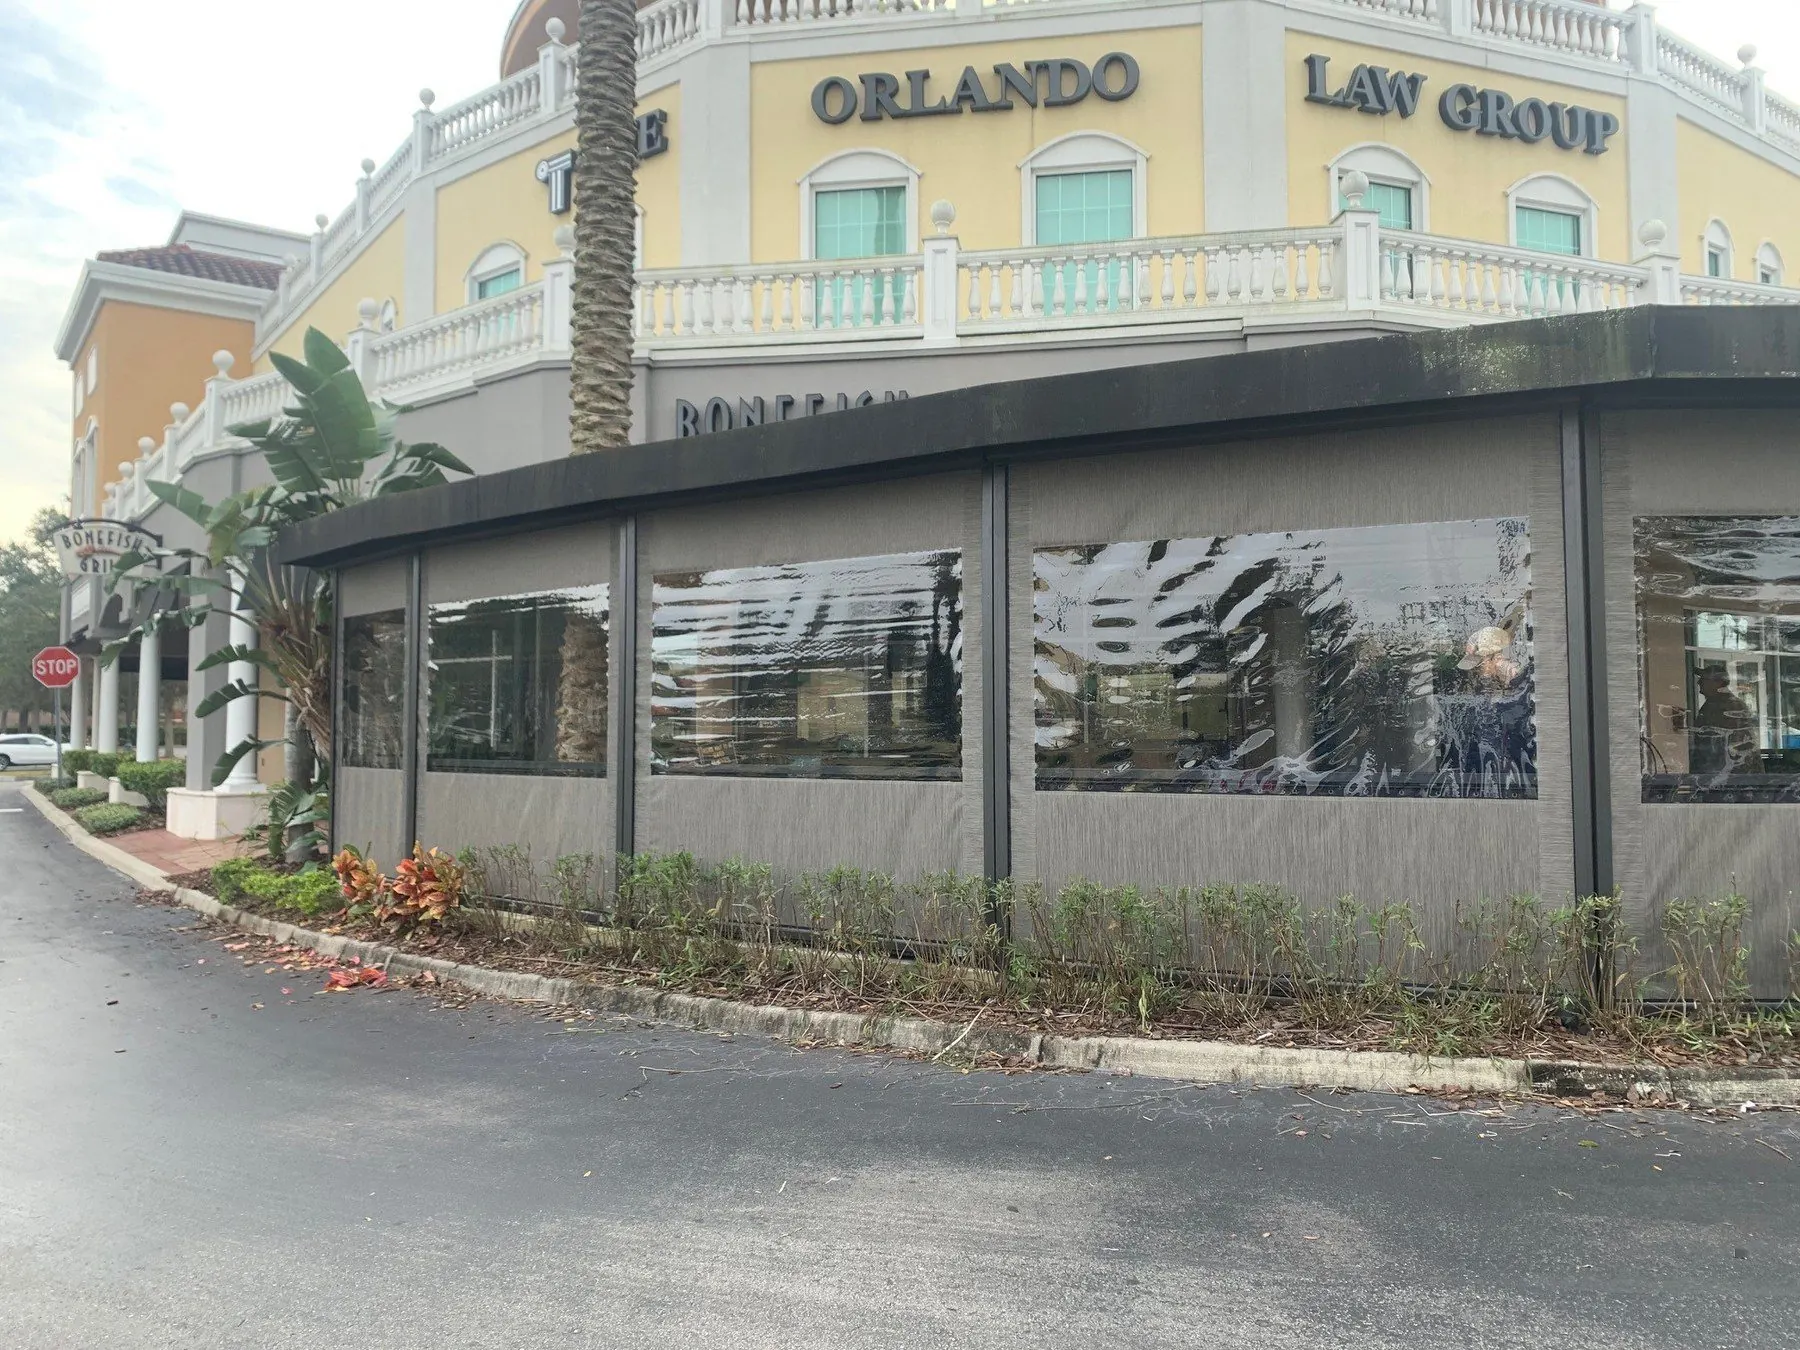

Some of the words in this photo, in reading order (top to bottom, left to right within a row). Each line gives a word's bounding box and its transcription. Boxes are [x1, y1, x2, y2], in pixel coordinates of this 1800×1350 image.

[535, 108, 669, 215] TE
[810, 51, 1140, 124] ORLANDO
[1304, 53, 1428, 118] LAW
[1439, 83, 1619, 155] GROUP
[61, 530, 142, 553] BONEFISH
[36, 660, 77, 676] STOP
